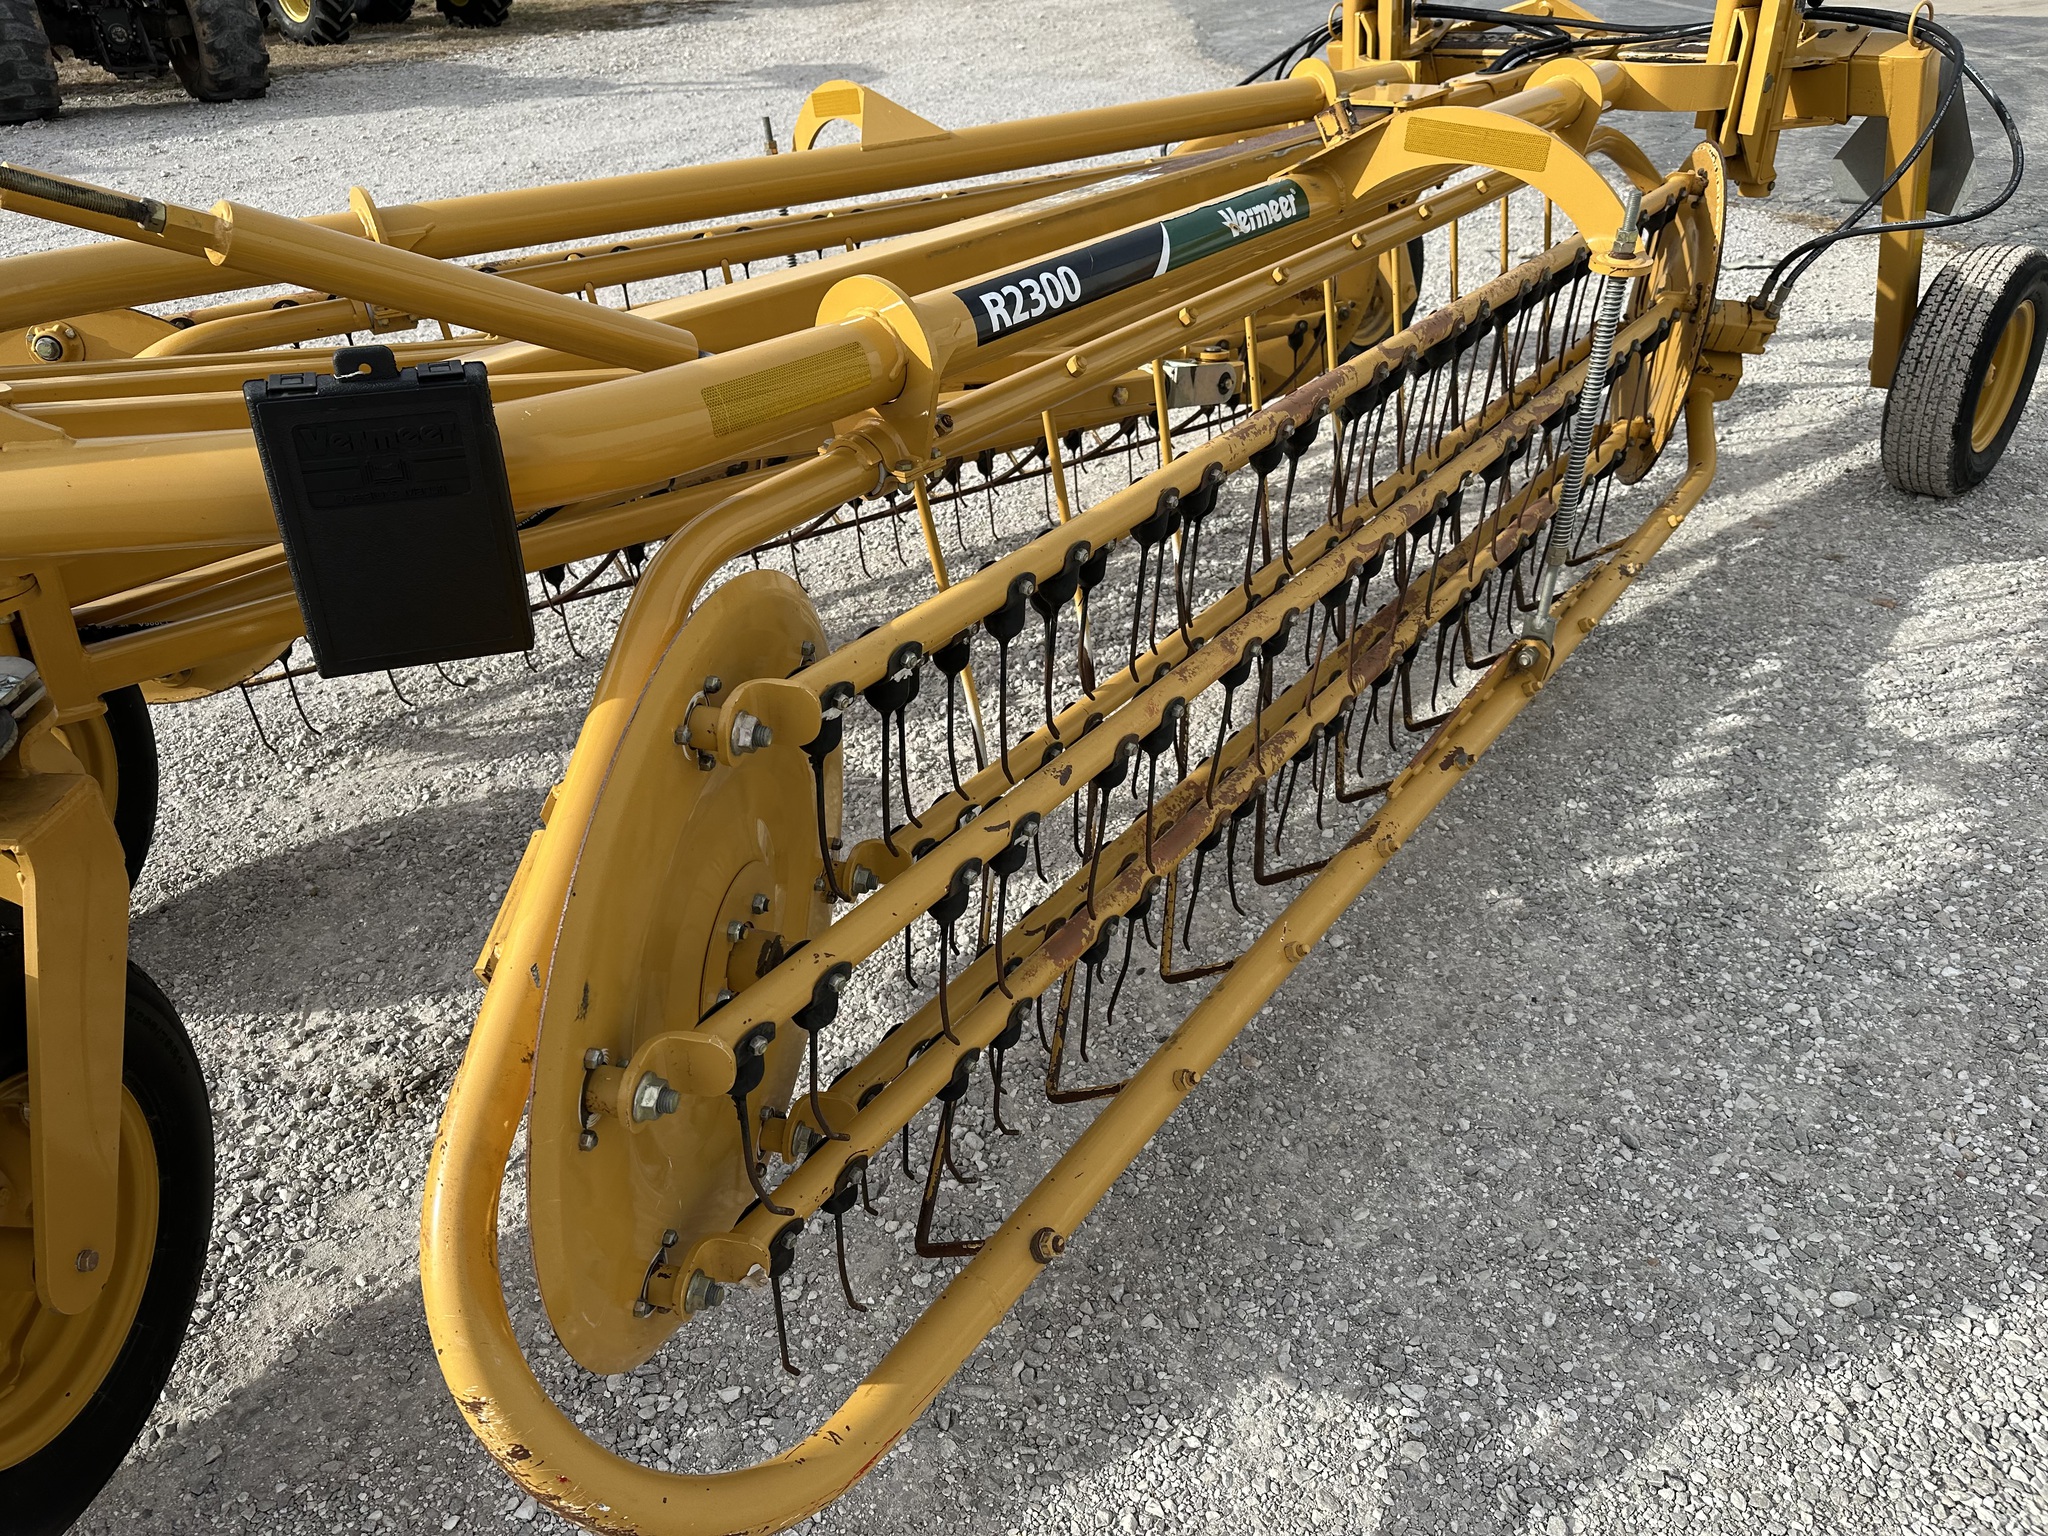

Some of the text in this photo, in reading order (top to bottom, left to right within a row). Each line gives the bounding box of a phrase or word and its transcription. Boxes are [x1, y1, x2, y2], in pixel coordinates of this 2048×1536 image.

[1217, 193, 1296, 238] Vermeer
[978, 265, 1082, 333] R2300
[298, 422, 457, 458] Vermeer
